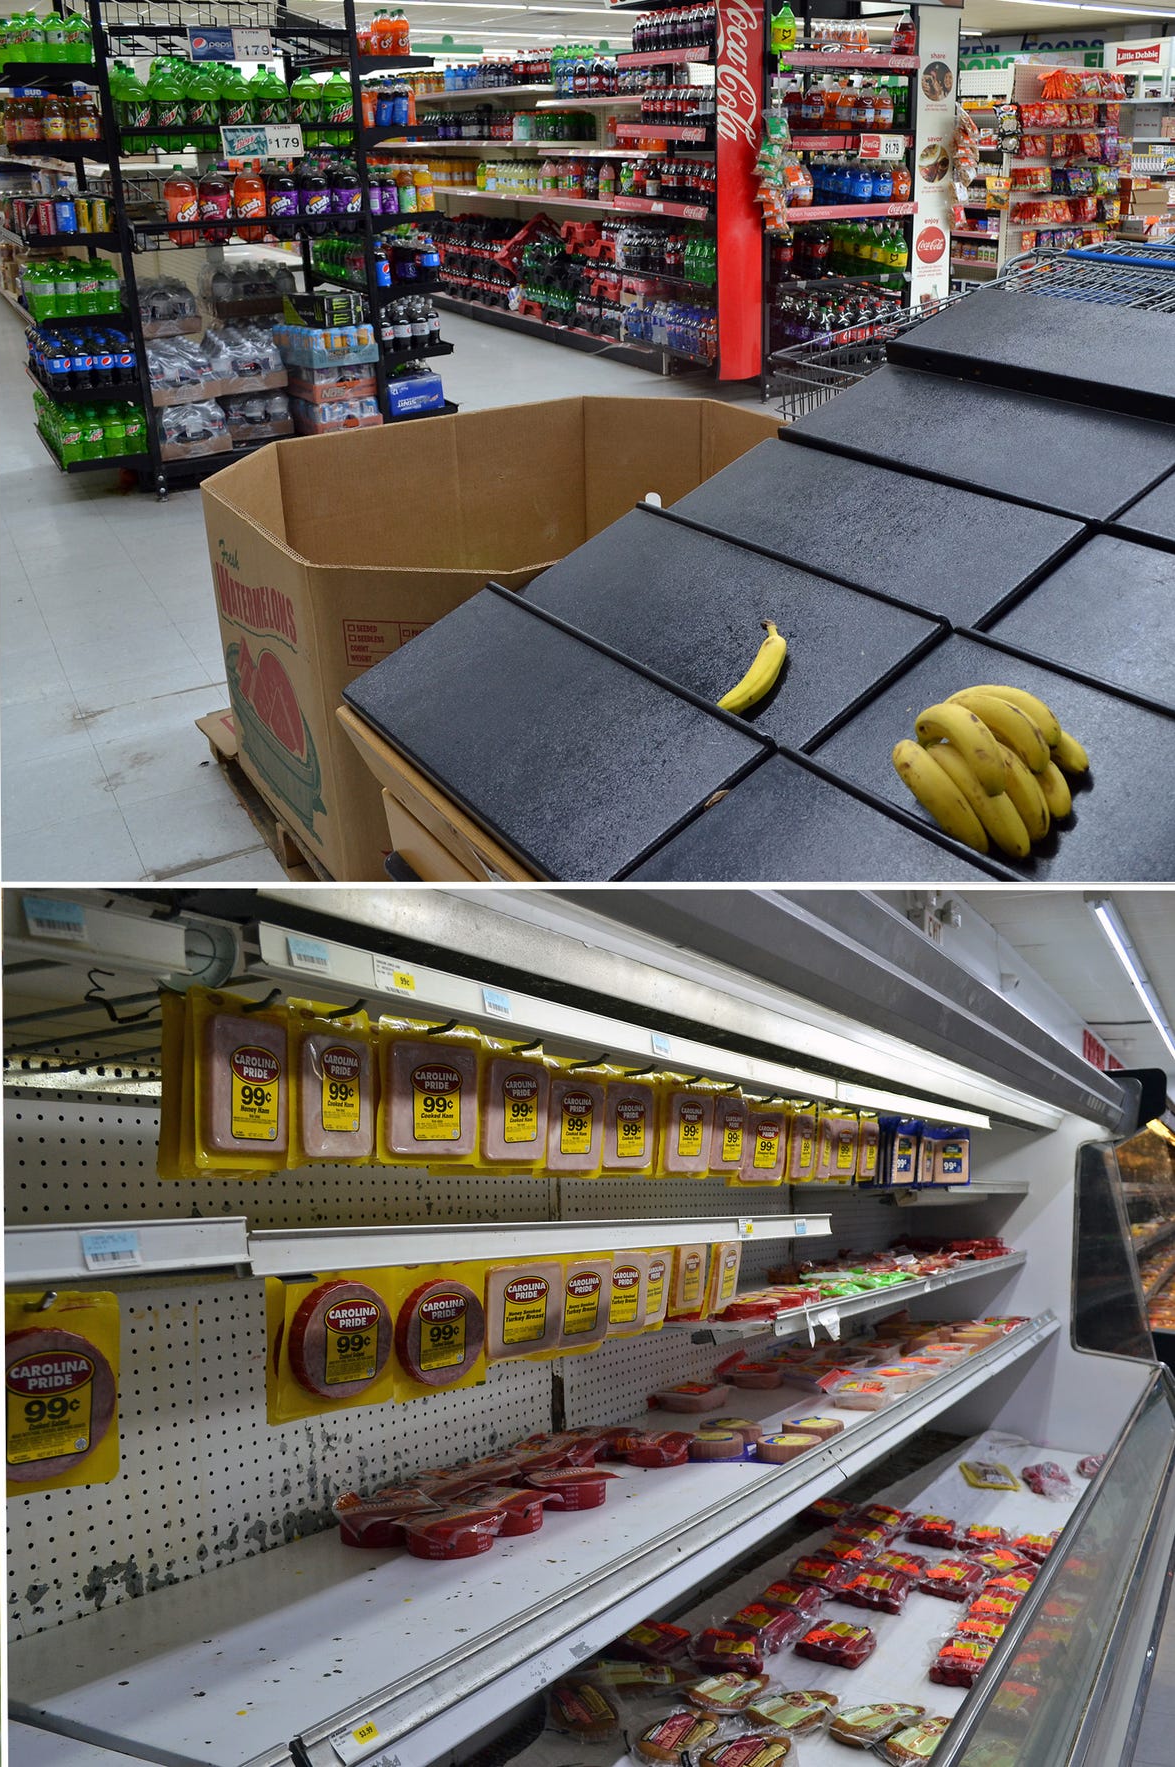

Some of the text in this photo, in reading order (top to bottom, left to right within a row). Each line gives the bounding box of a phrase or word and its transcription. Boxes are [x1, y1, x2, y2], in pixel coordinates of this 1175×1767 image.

[889, 56, 916, 67] Coca-Cola
[1118, 50, 1159, 60] Little Debbie
[717, 0, 757, 149] Coca-Cola
[885, 142, 900, 155] $1.79
[236, 197, 262, 219] Crush
[305, 195, 331, 216] Crush
[683, 205, 708, 218] Coca-Cola
[888, 203, 914, 214] Coca-Cola
[917, 238, 945, 252] Coca-Cola
[321, 386, 346, 399] NOS
[215, 560, 298, 645] WATERMELONS
[357, 634, 385, 643] SEEDLESS
[234, 1054, 278, 1070] CAROLINA
[324, 1055, 358, 1067] CAROLINA
[243, 1066, 268, 1079] PRIDE
[330, 1065, 351, 1076] PRIDE
[415, 1071, 459, 1081] CAROLINA
[425, 1081, 449, 1090] PRIDE
[505, 1080, 537, 1089] CAROLINA
[241, 1085, 272, 1106] 99¢
[329, 1082, 354, 1101] 99¢
[512, 1089, 531, 1097] PRIDE
[240, 1104, 270, 1114] Honey Ham
[423, 1096, 453, 1113] 99¢
[511, 1103, 533, 1118] 99¢
[681, 1107, 703, 1115] CAROLINA
[568, 1118, 588, 1131] 99¢
[623, 1124, 642, 1136] 99¢
[613, 1271, 639, 1279] CAROLINA
[507, 1282, 546, 1293] CAROLINA
[569, 1278, 599, 1287] CAROLINA
[618, 1278, 633, 1286] PRIDE
[515, 1291, 538, 1300] PRIDE
[574, 1285, 593, 1294] PRIDE
[423, 1299, 464, 1312] CAROLINA
[329, 1307, 377, 1320] CAROLINA
[431, 1308, 456, 1319] PRIDE
[339, 1317, 367, 1328] PRIDE
[429, 1324, 459, 1343] 99¢
[336, 1335, 371, 1354] 99¢
[9, 1359, 89, 1379] CAROLINA
[27, 1374, 73, 1390] PRIDE
[24, 1397, 81, 1423] 99¢
